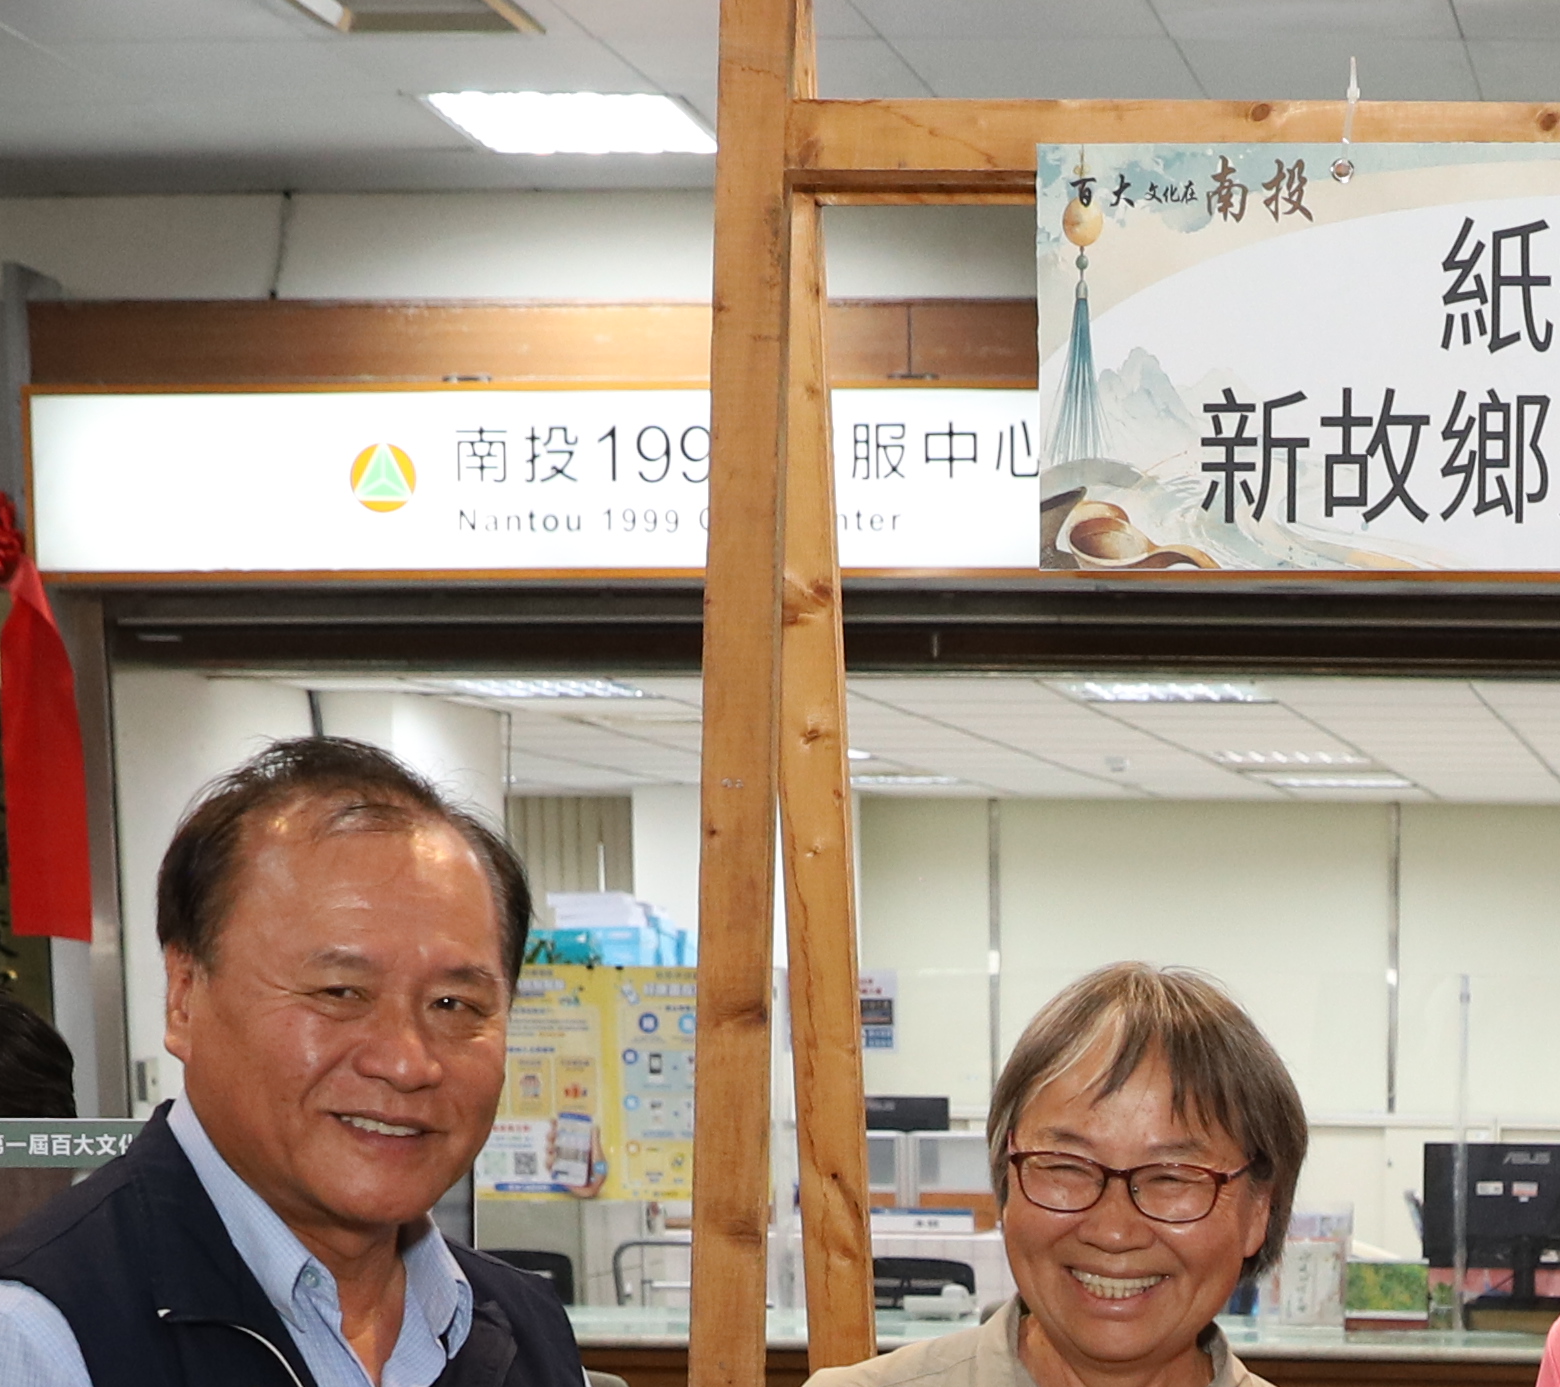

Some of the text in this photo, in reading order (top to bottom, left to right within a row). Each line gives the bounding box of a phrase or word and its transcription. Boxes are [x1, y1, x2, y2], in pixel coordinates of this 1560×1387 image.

[1070, 155, 1314, 222] 百大文化在南投
[458, 509, 582, 532] Nantou
[603, 509, 680, 532] 1999
